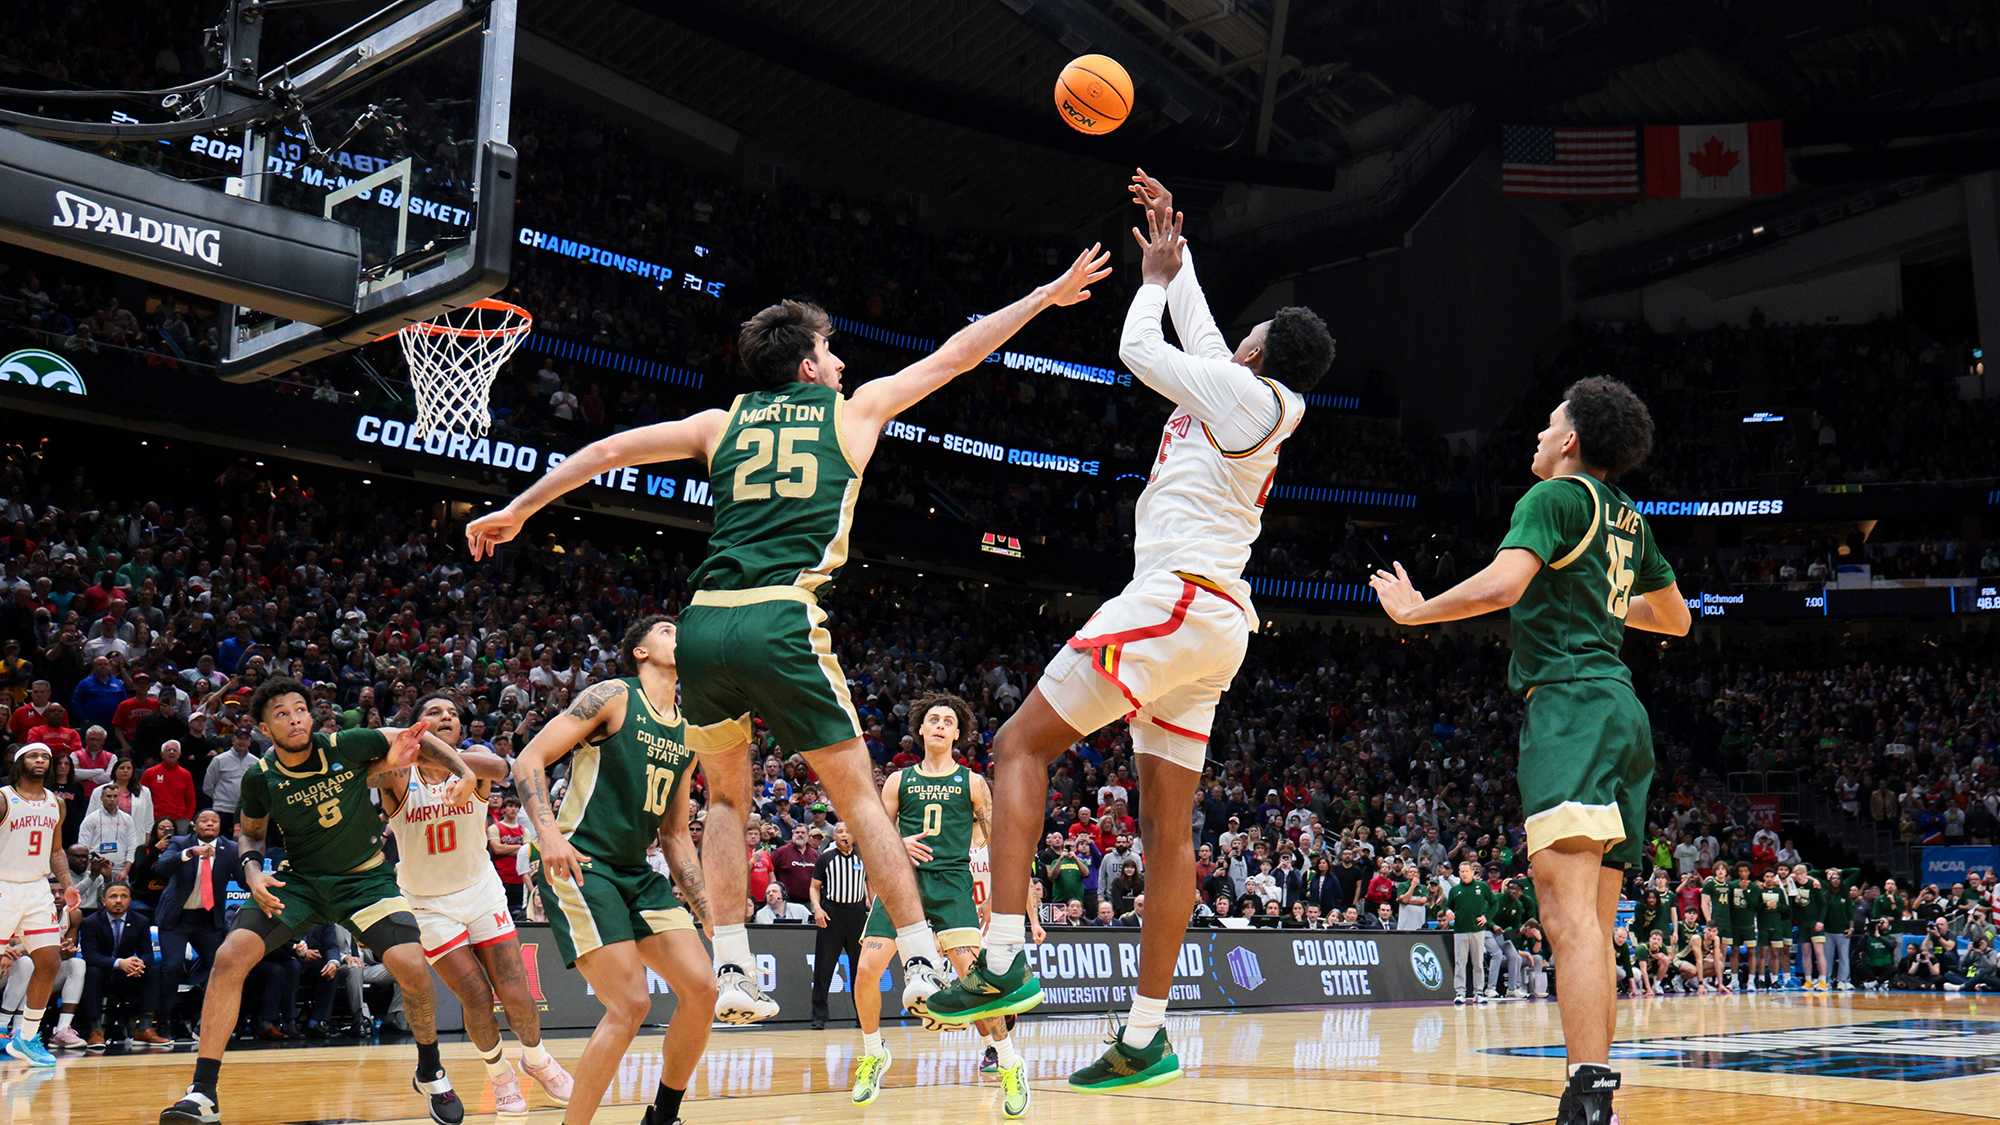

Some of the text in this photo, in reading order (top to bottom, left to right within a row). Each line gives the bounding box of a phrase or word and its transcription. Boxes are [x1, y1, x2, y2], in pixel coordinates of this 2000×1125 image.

[53, 190, 223, 268] SPALDING
[738, 402, 825, 426] MORTON
[356, 415, 537, 473] COLORADO
[647, 474, 676, 499] VS
[732, 426, 821, 502] 25
[942, 433, 1004, 462] SECOND
[1007, 447, 1080, 474] ROUNDS
[1605, 503, 1641, 536] LAKE
[1635, 499, 1784, 517] MARCHMADNESS
[1703, 593, 1744, 604] Richmond
[1703, 605, 1725, 616] UCLA
[1804, 596, 1824, 608] 7:00
[636, 729, 690, 758] COLORADO
[646, 745, 680, 766] STATE
[286, 770, 355, 805] COLORADO
[303, 783, 344, 807] STATE
[643, 763, 675, 817] 10
[907, 784, 962, 795] COLORADO
[919, 792, 950, 801] STATE
[317, 796, 344, 829] 5
[405, 800, 474, 825] MARYLAND
[923, 803, 943, 837] 0
[27, 830, 43, 857] 9
[424, 819, 457, 856] 10
[1292, 939, 1380, 967] COLORADO
[1041, 986, 1110, 1005] UNIVERSITY
[1112, 986, 1128, 1003] OF
[1320, 969, 1372, 997] STATE
